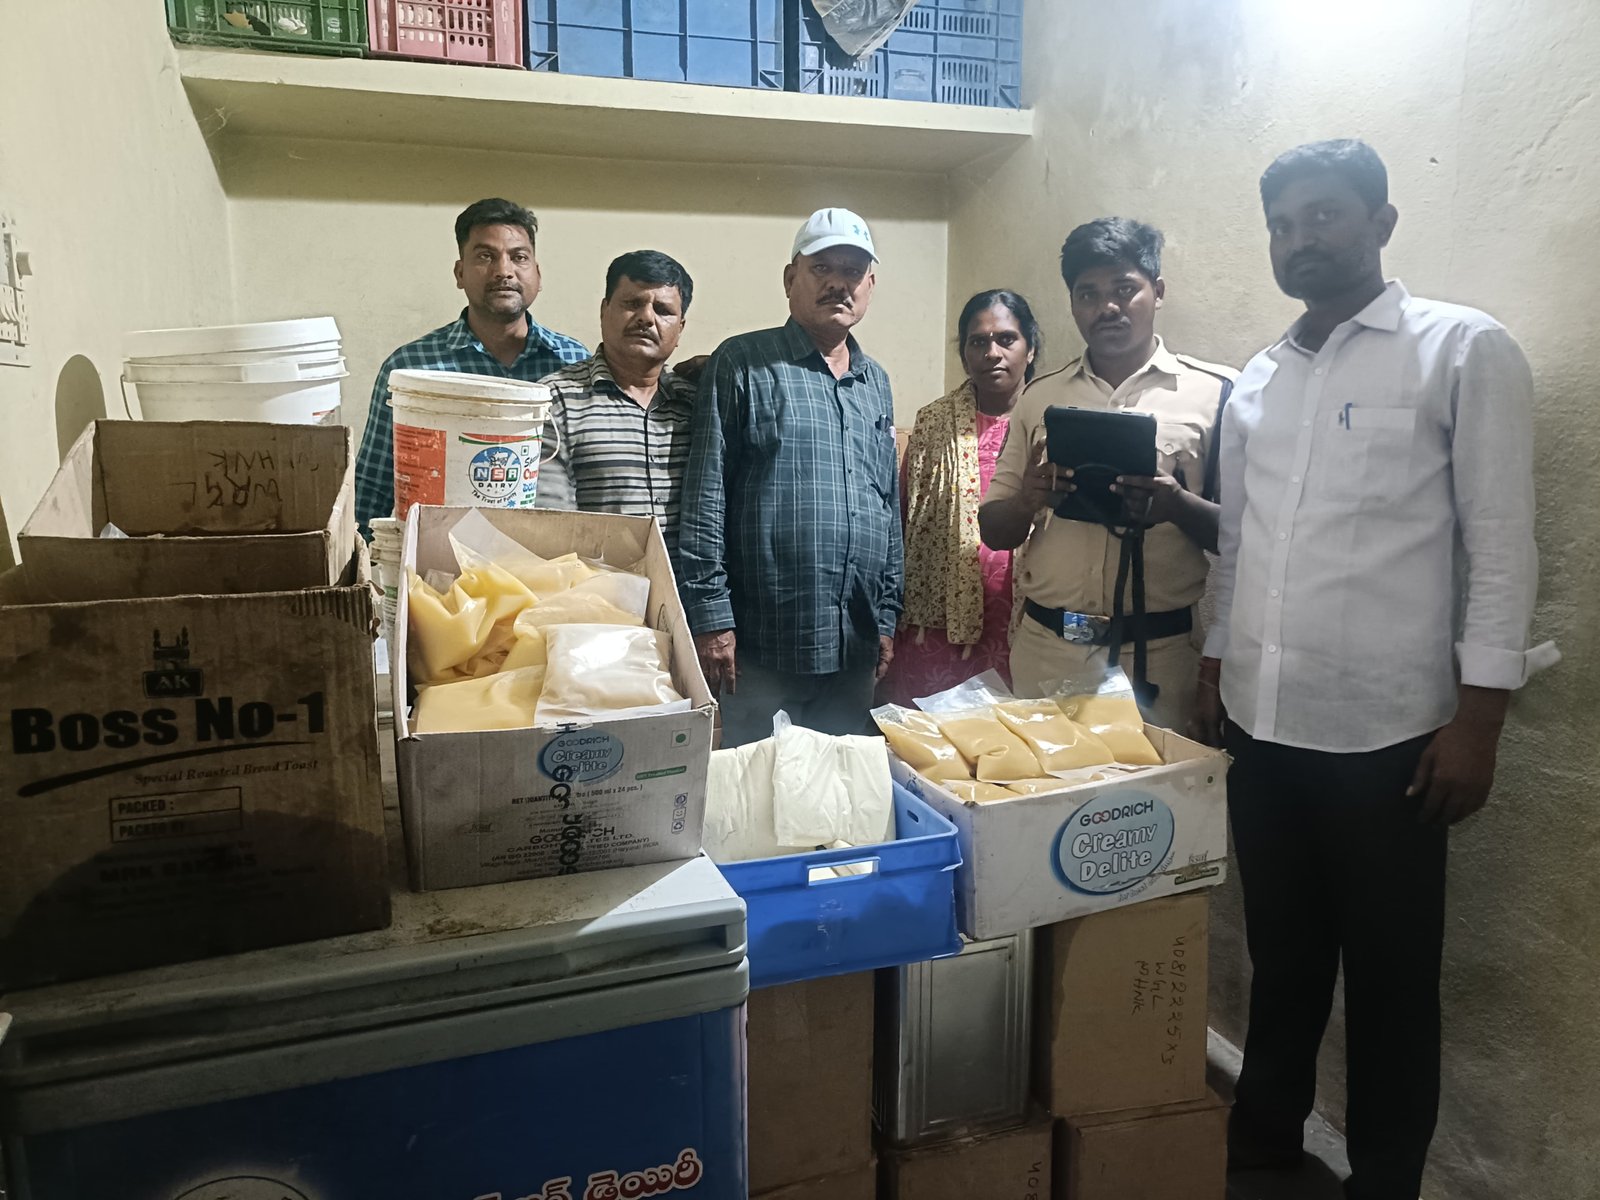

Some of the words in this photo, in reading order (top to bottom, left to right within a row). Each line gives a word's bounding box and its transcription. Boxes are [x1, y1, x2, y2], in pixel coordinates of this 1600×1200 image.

[156, 675, 191, 690] AK
[551, 747, 613, 764] Creamy
[135, 771, 183, 787] Special
[282, 759, 319, 772] Toast
[1080, 800, 1154, 827] GOODRICH
[1071, 822, 1158, 859] Creamy
[1080, 850, 1153, 883] Delite
